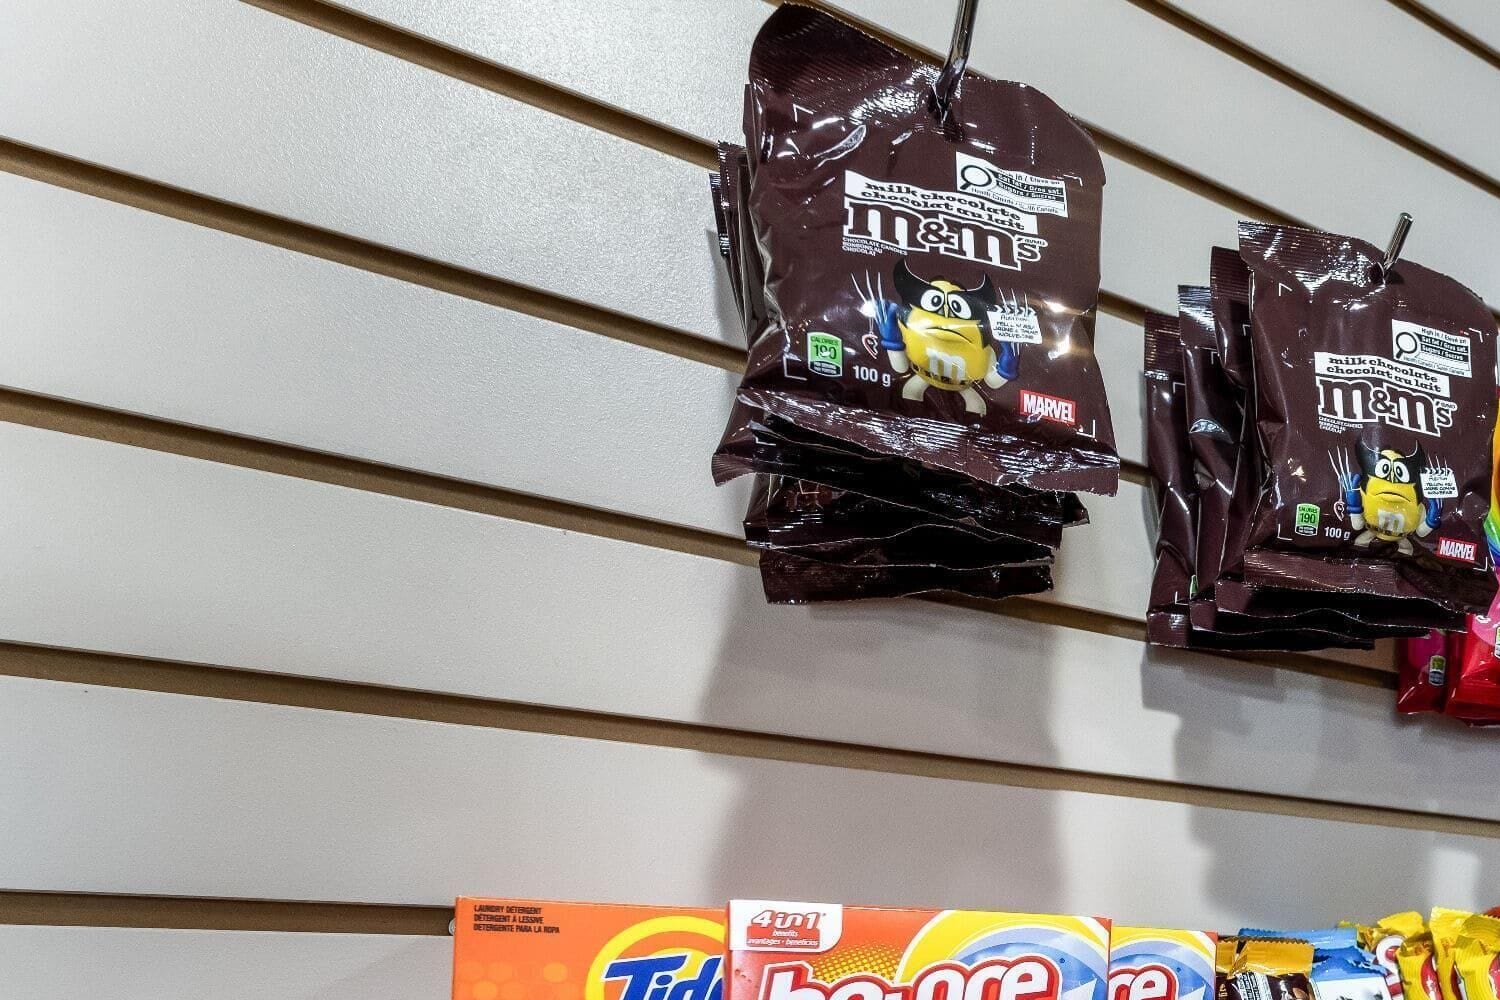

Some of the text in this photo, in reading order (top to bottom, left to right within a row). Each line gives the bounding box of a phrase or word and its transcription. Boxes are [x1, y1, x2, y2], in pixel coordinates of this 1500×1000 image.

[861, 190, 1025, 231] chocolat au lait
[865, 182, 919, 198] milk
[921, 188, 1021, 222] chocolate
[852, 365, 891, 387] 100 g
[1327, 365, 1442, 393] chocolat au lait
[1329, 356, 1438, 383] milk chocolate
[1023, 393, 1075, 423] MARVEL
[1300, 512, 1316, 524] 190
[1324, 526, 1342, 539] 100
[1440, 539, 1475, 561] MARVEL
[474, 904, 542, 915] LAUNDRY DETERGENT
